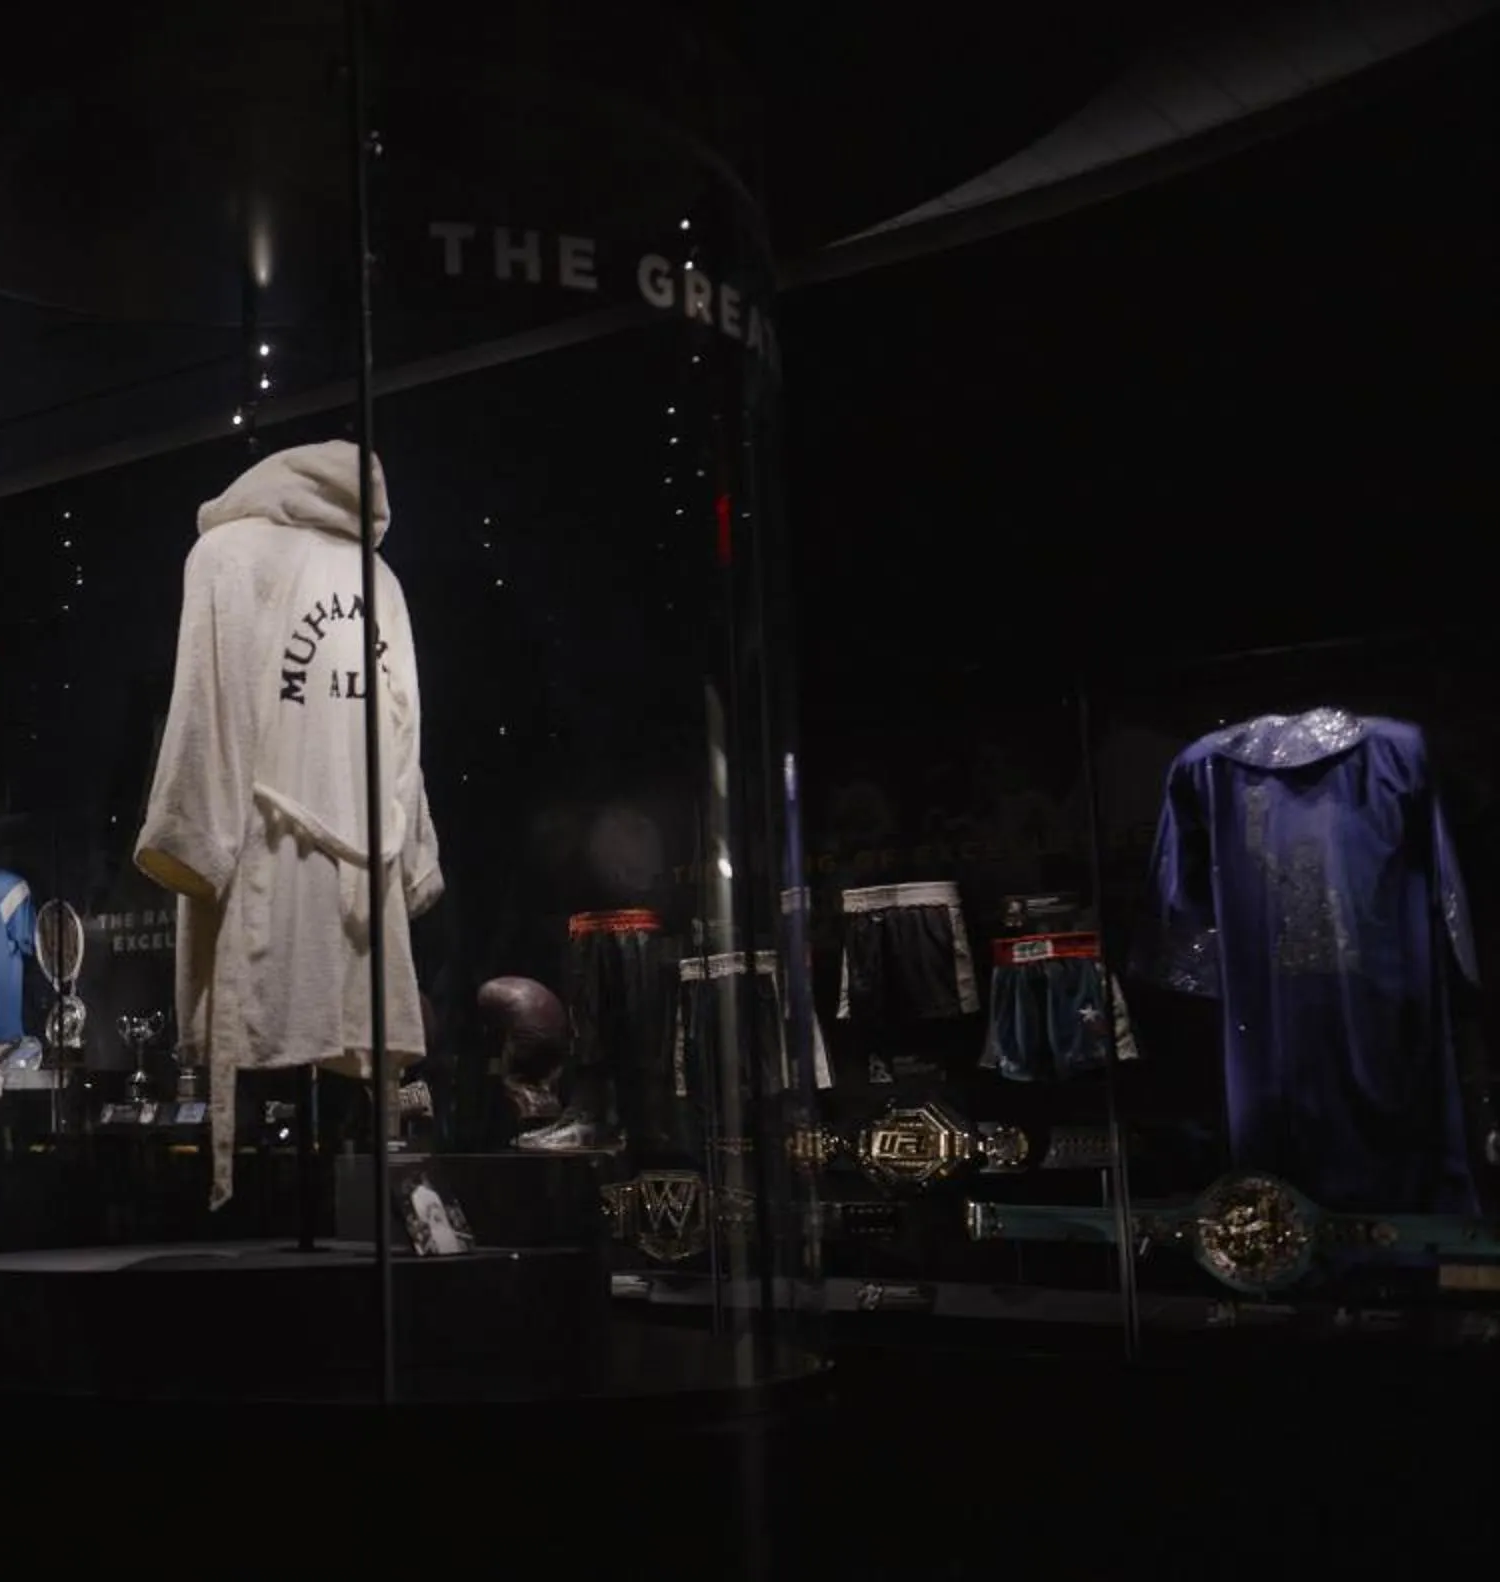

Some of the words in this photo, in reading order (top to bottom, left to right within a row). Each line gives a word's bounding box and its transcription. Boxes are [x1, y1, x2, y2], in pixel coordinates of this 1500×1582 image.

[428, 221, 599, 292] THE
[330, 670, 367, 699] AL
[97, 912, 135, 929] THE
[142, 908, 176, 926] RA
